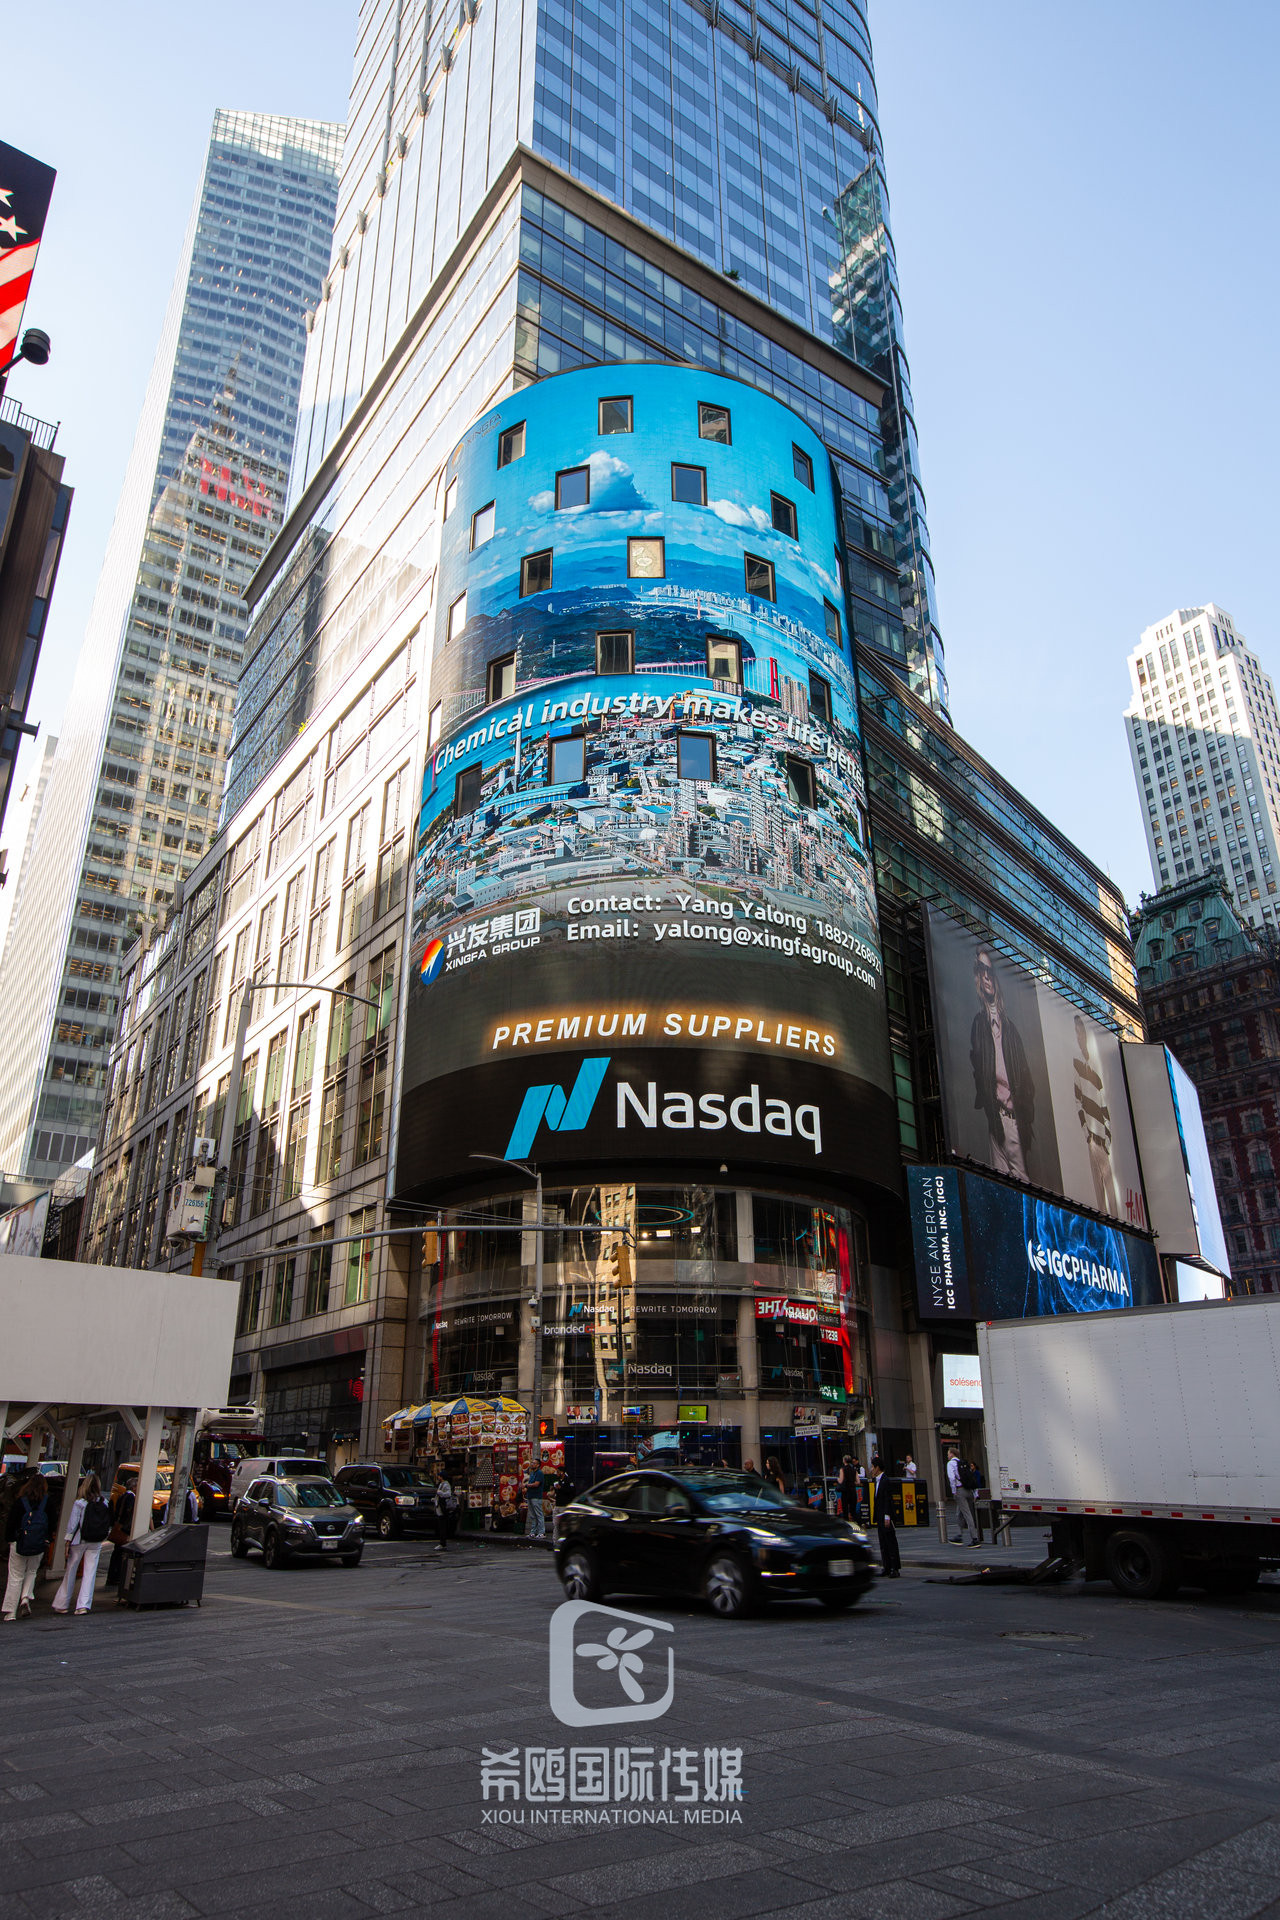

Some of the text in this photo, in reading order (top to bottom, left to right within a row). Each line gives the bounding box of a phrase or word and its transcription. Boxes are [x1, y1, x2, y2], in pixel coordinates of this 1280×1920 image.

[435, 692, 865, 787] Chemical industry makes life better
[446, 907, 541, 959] 兴发集团
[567, 895, 884, 976] Contact: Yang Yalong 18827268921
[445, 936, 541, 972] XINGFA GROUP
[567, 918, 876, 989] Email: yalong@xingfagroup.com
[492, 1013, 836, 1056] PREMIUM SUPPLIERS
[616, 1081, 823, 1155] Nasdaq
[185, 1199, 205, 1207] 726156
[935, 1175, 947, 1203] (IGC)
[1125, 1187, 1145, 1228] H&M
[938, 1206, 948, 1230] INC.
[922, 1177, 944, 1306] NYSE AMERICAN
[477, 1312, 512, 1322] TOMORROW
[583, 1305, 718, 1314] Nasdaq REWRITE TOMORROW
[945, 1289, 956, 1310] IGC
[628, 1363, 672, 1376] Nasdaq
